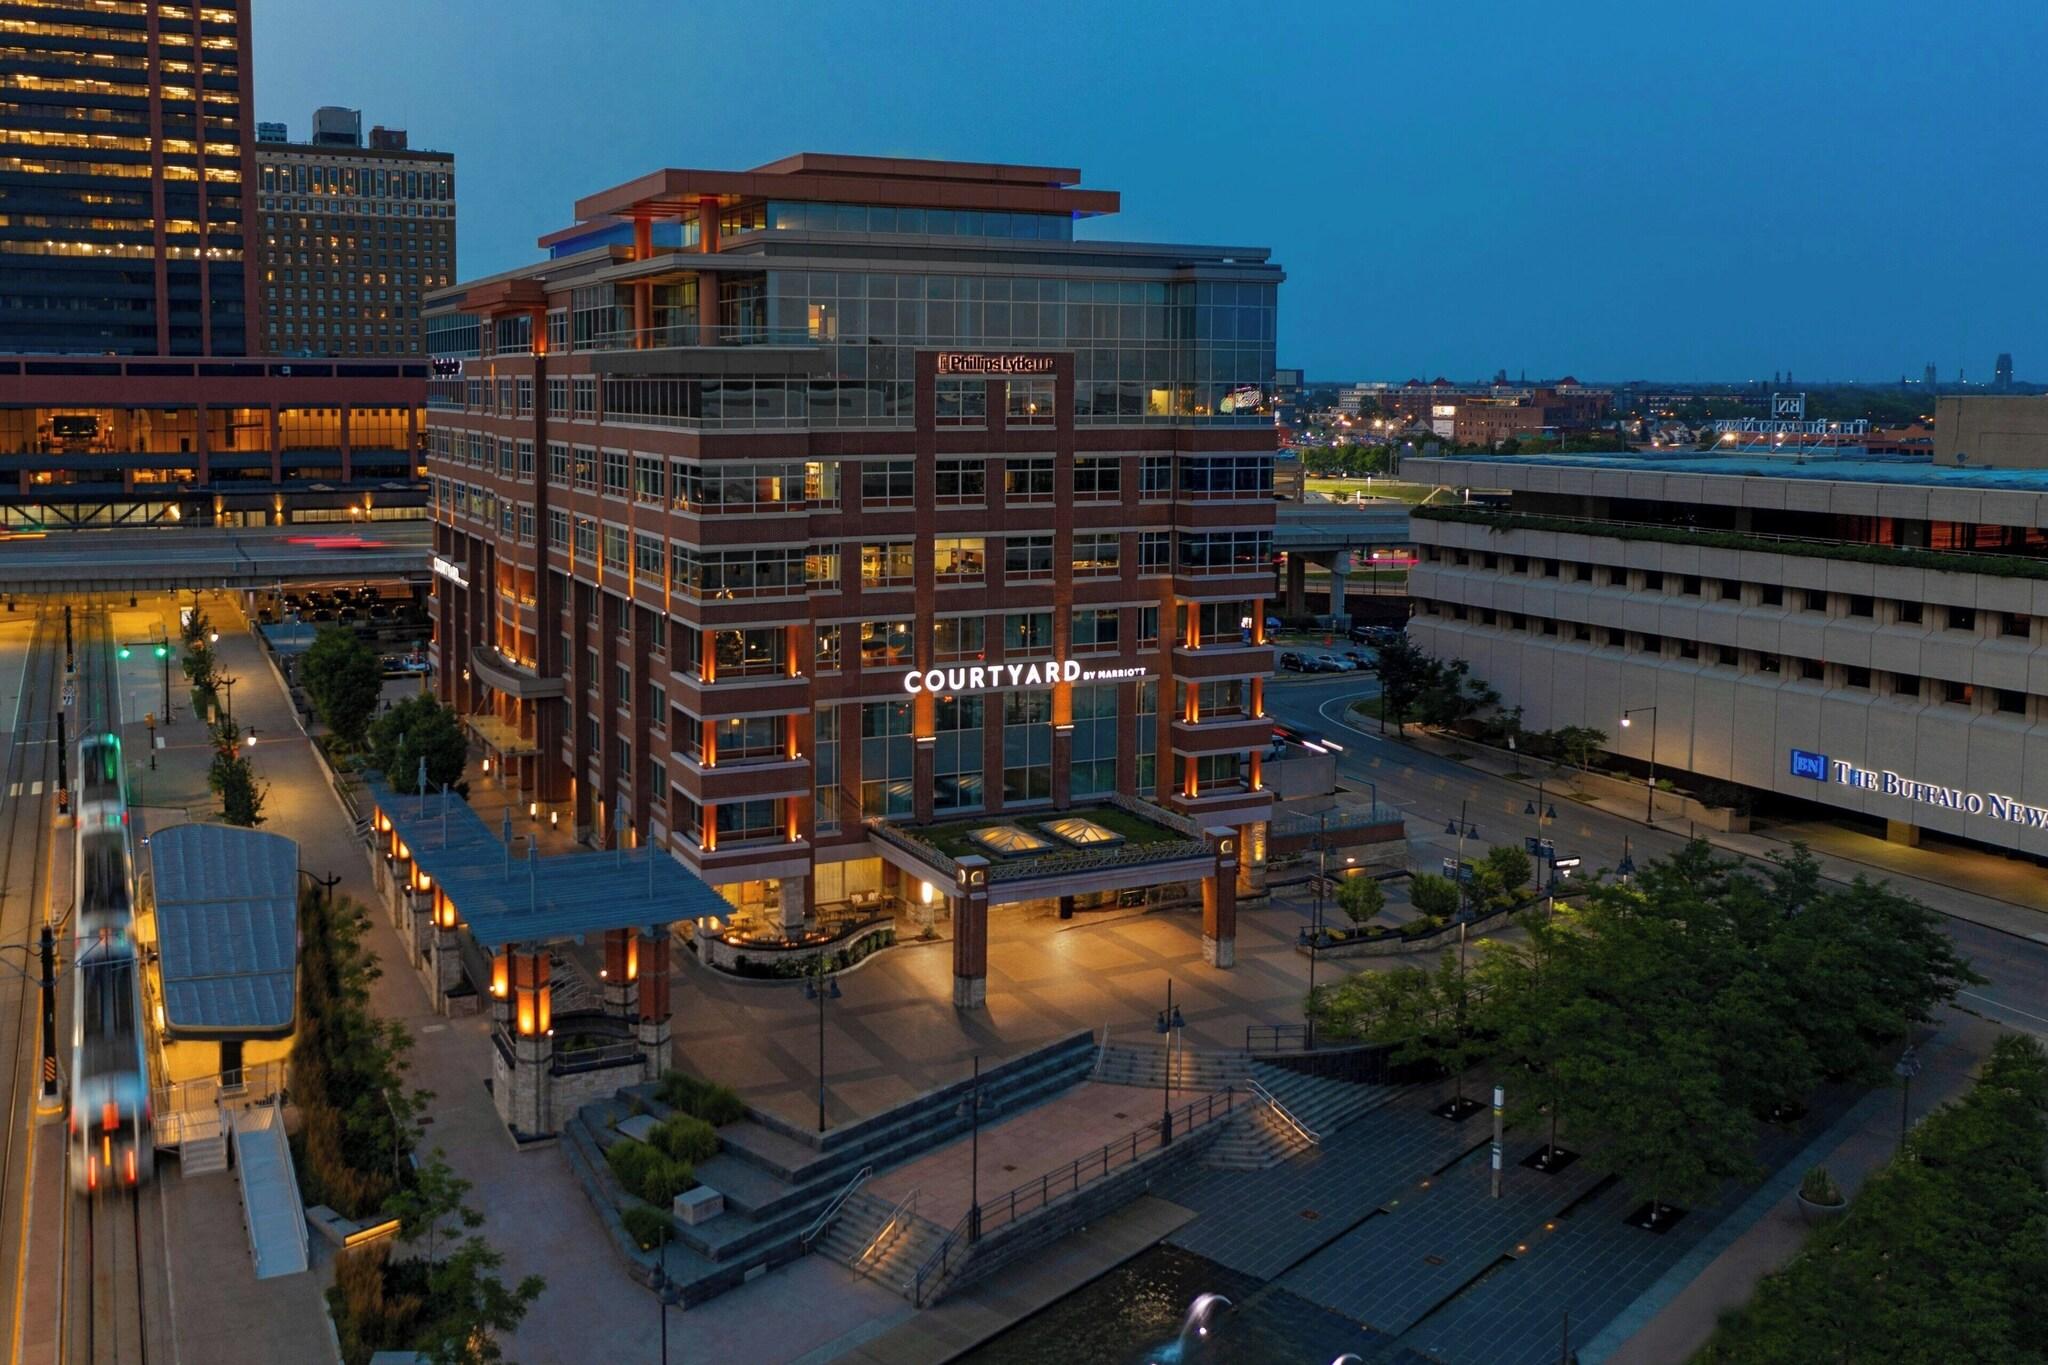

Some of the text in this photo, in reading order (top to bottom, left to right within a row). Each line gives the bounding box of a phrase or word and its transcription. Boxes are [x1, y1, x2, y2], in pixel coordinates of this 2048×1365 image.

[949, 354, 1001, 373] Phillips
[1001, 354, 1034, 374] Lytle
[904, 660, 1147, 693] COURTYARD BY MARRIOTT
[1832, 759, 1878, 792] THE
[1882, 770, 1984, 816] BUFFALO
